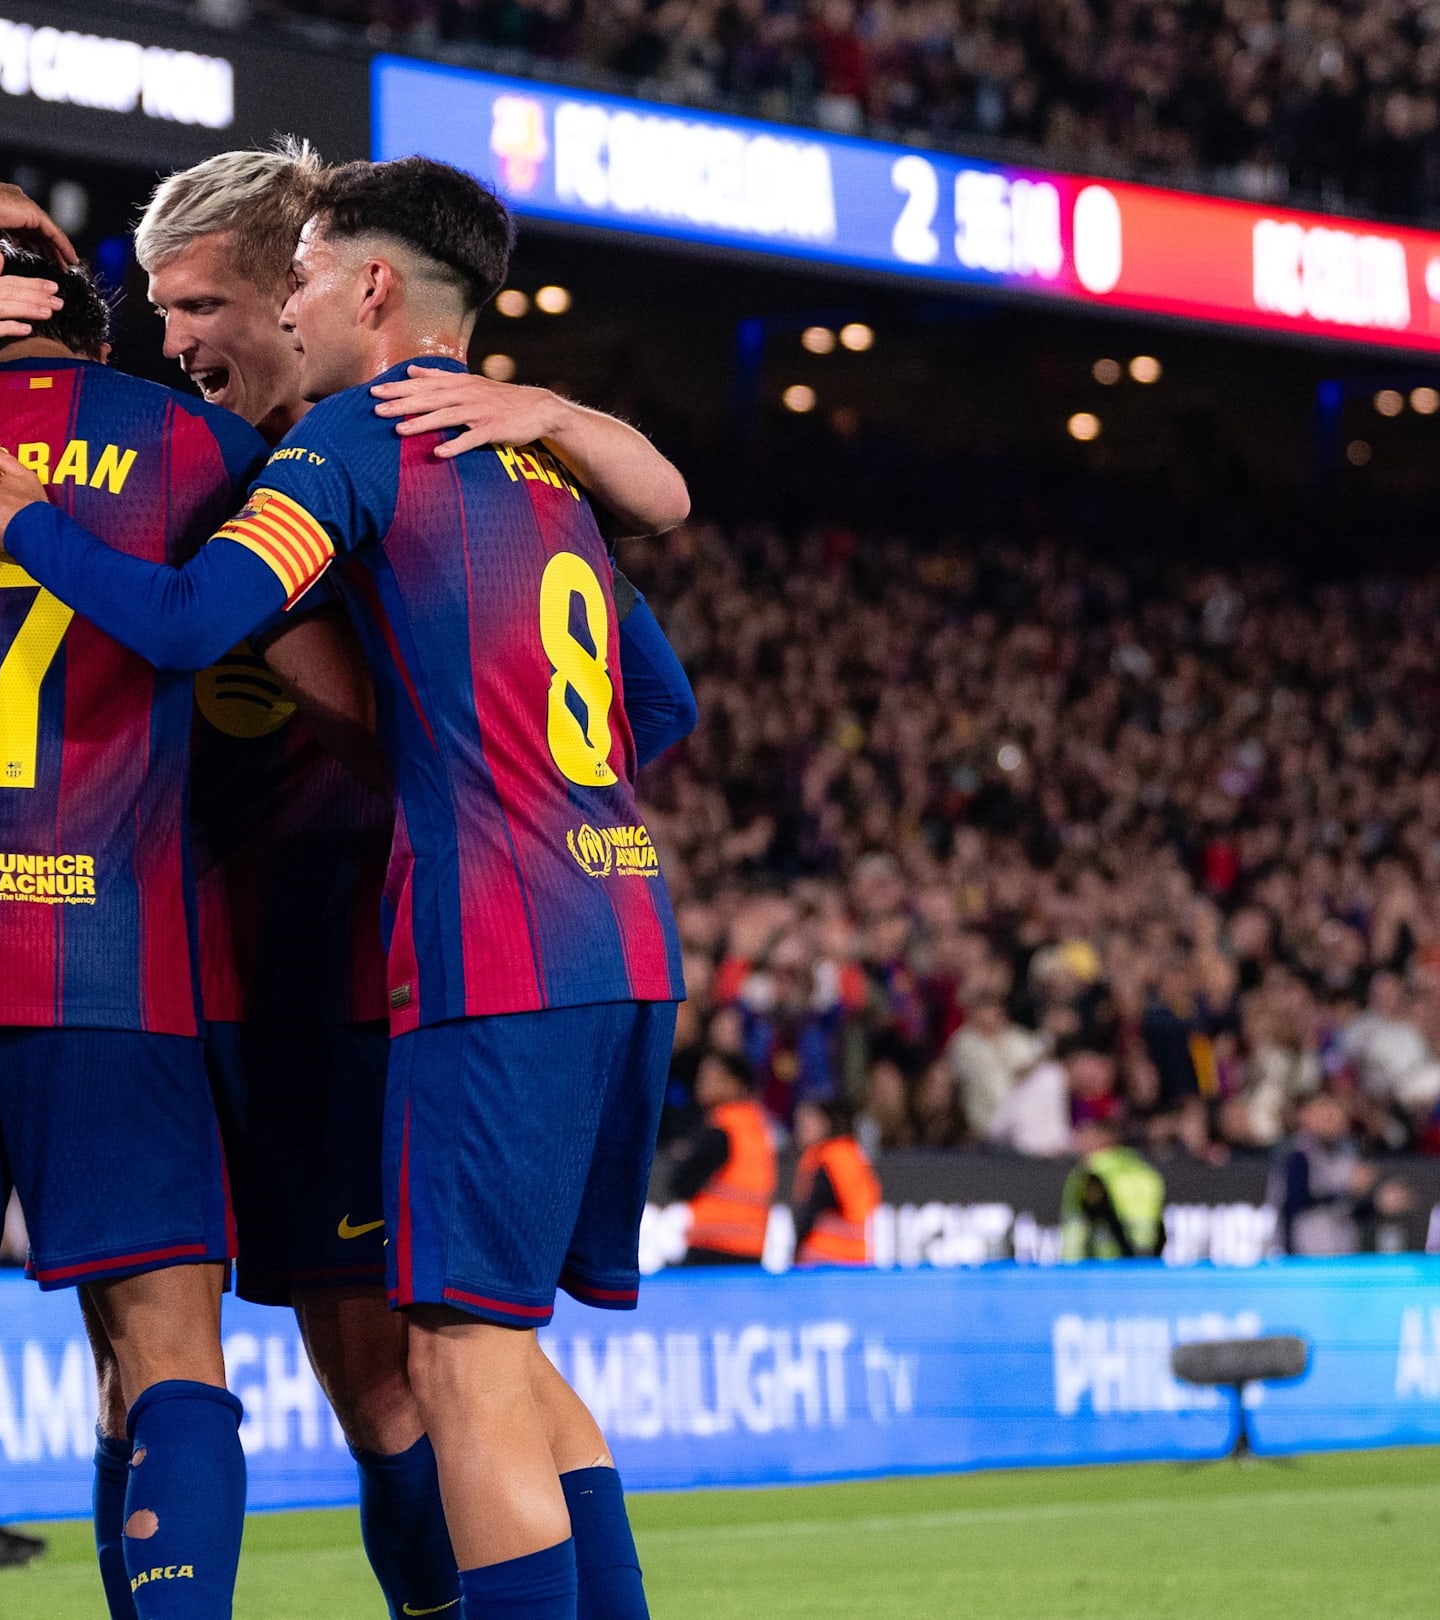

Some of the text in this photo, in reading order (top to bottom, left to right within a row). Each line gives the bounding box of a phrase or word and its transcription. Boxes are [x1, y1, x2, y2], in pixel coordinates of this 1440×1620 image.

[891, 155, 939, 265] 2
[1073, 184, 1122, 294] 0
[539, 551, 619, 787] 8
[30, 894, 64, 905] Refugee
[64, 895, 96, 906] Agency
[538, 1311, 854, 1444] MBILIGHT
